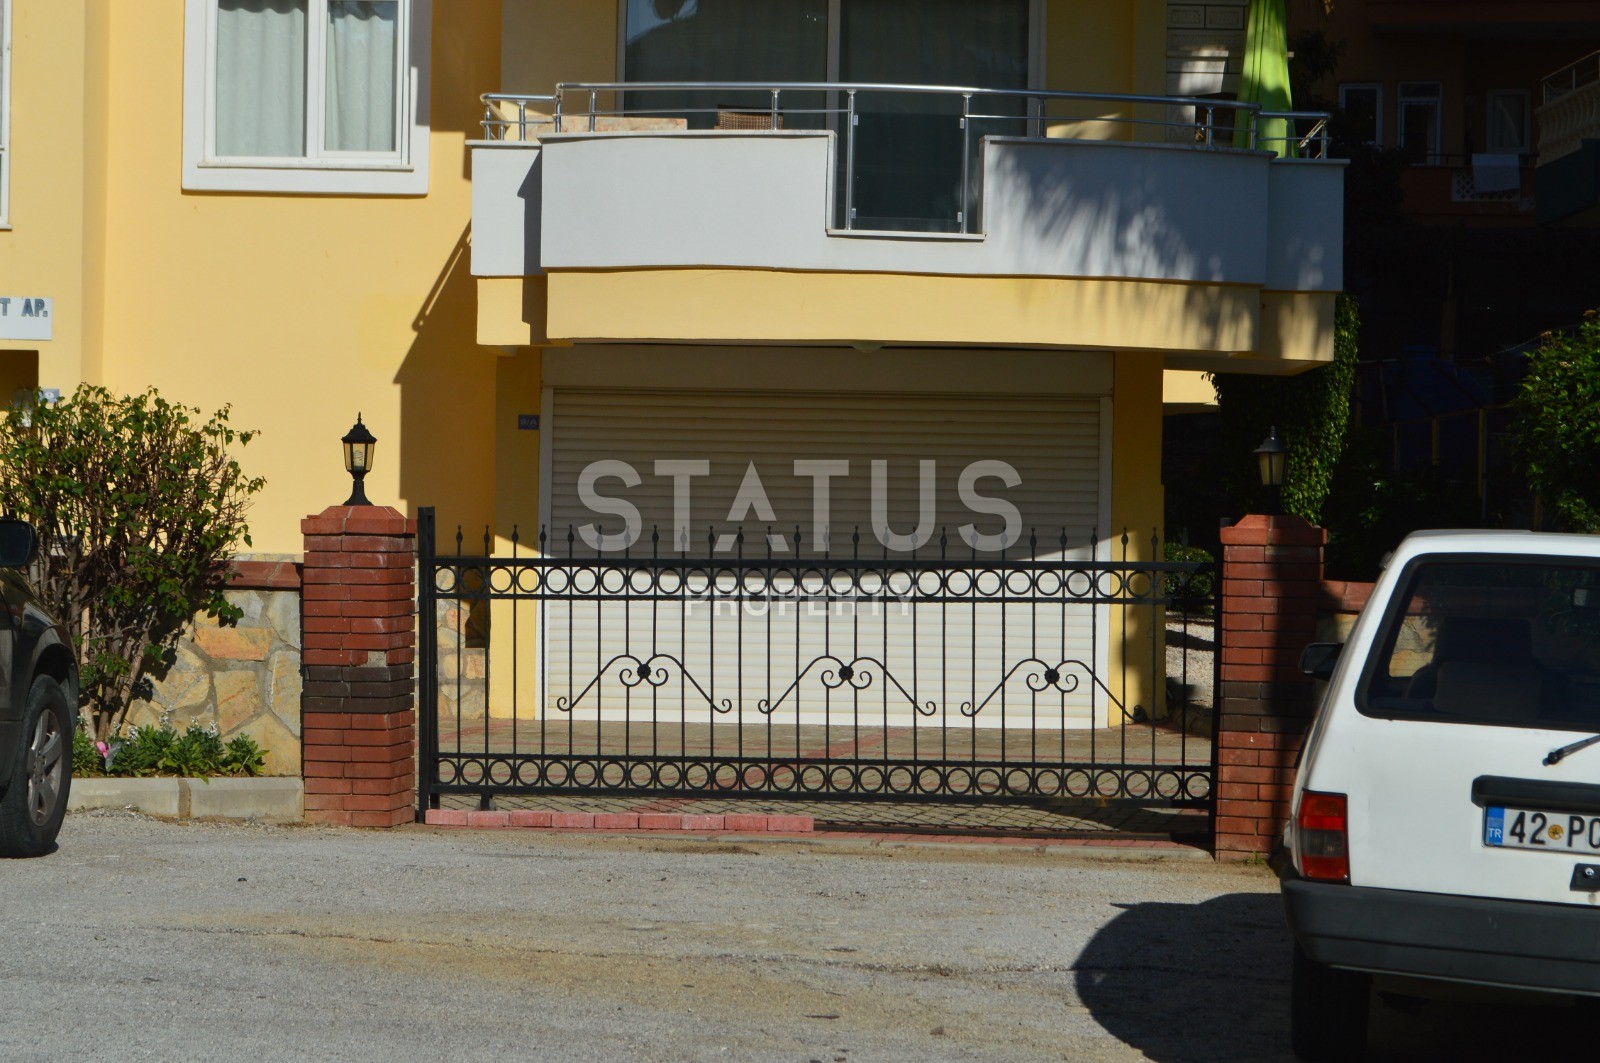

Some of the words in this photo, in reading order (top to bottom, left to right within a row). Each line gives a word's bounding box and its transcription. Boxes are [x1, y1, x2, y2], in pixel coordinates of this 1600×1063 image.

[21, 298, 48, 317] AP.
[1487, 827, 1502, 839] TR
[1509, 811, 1548, 845] 42
